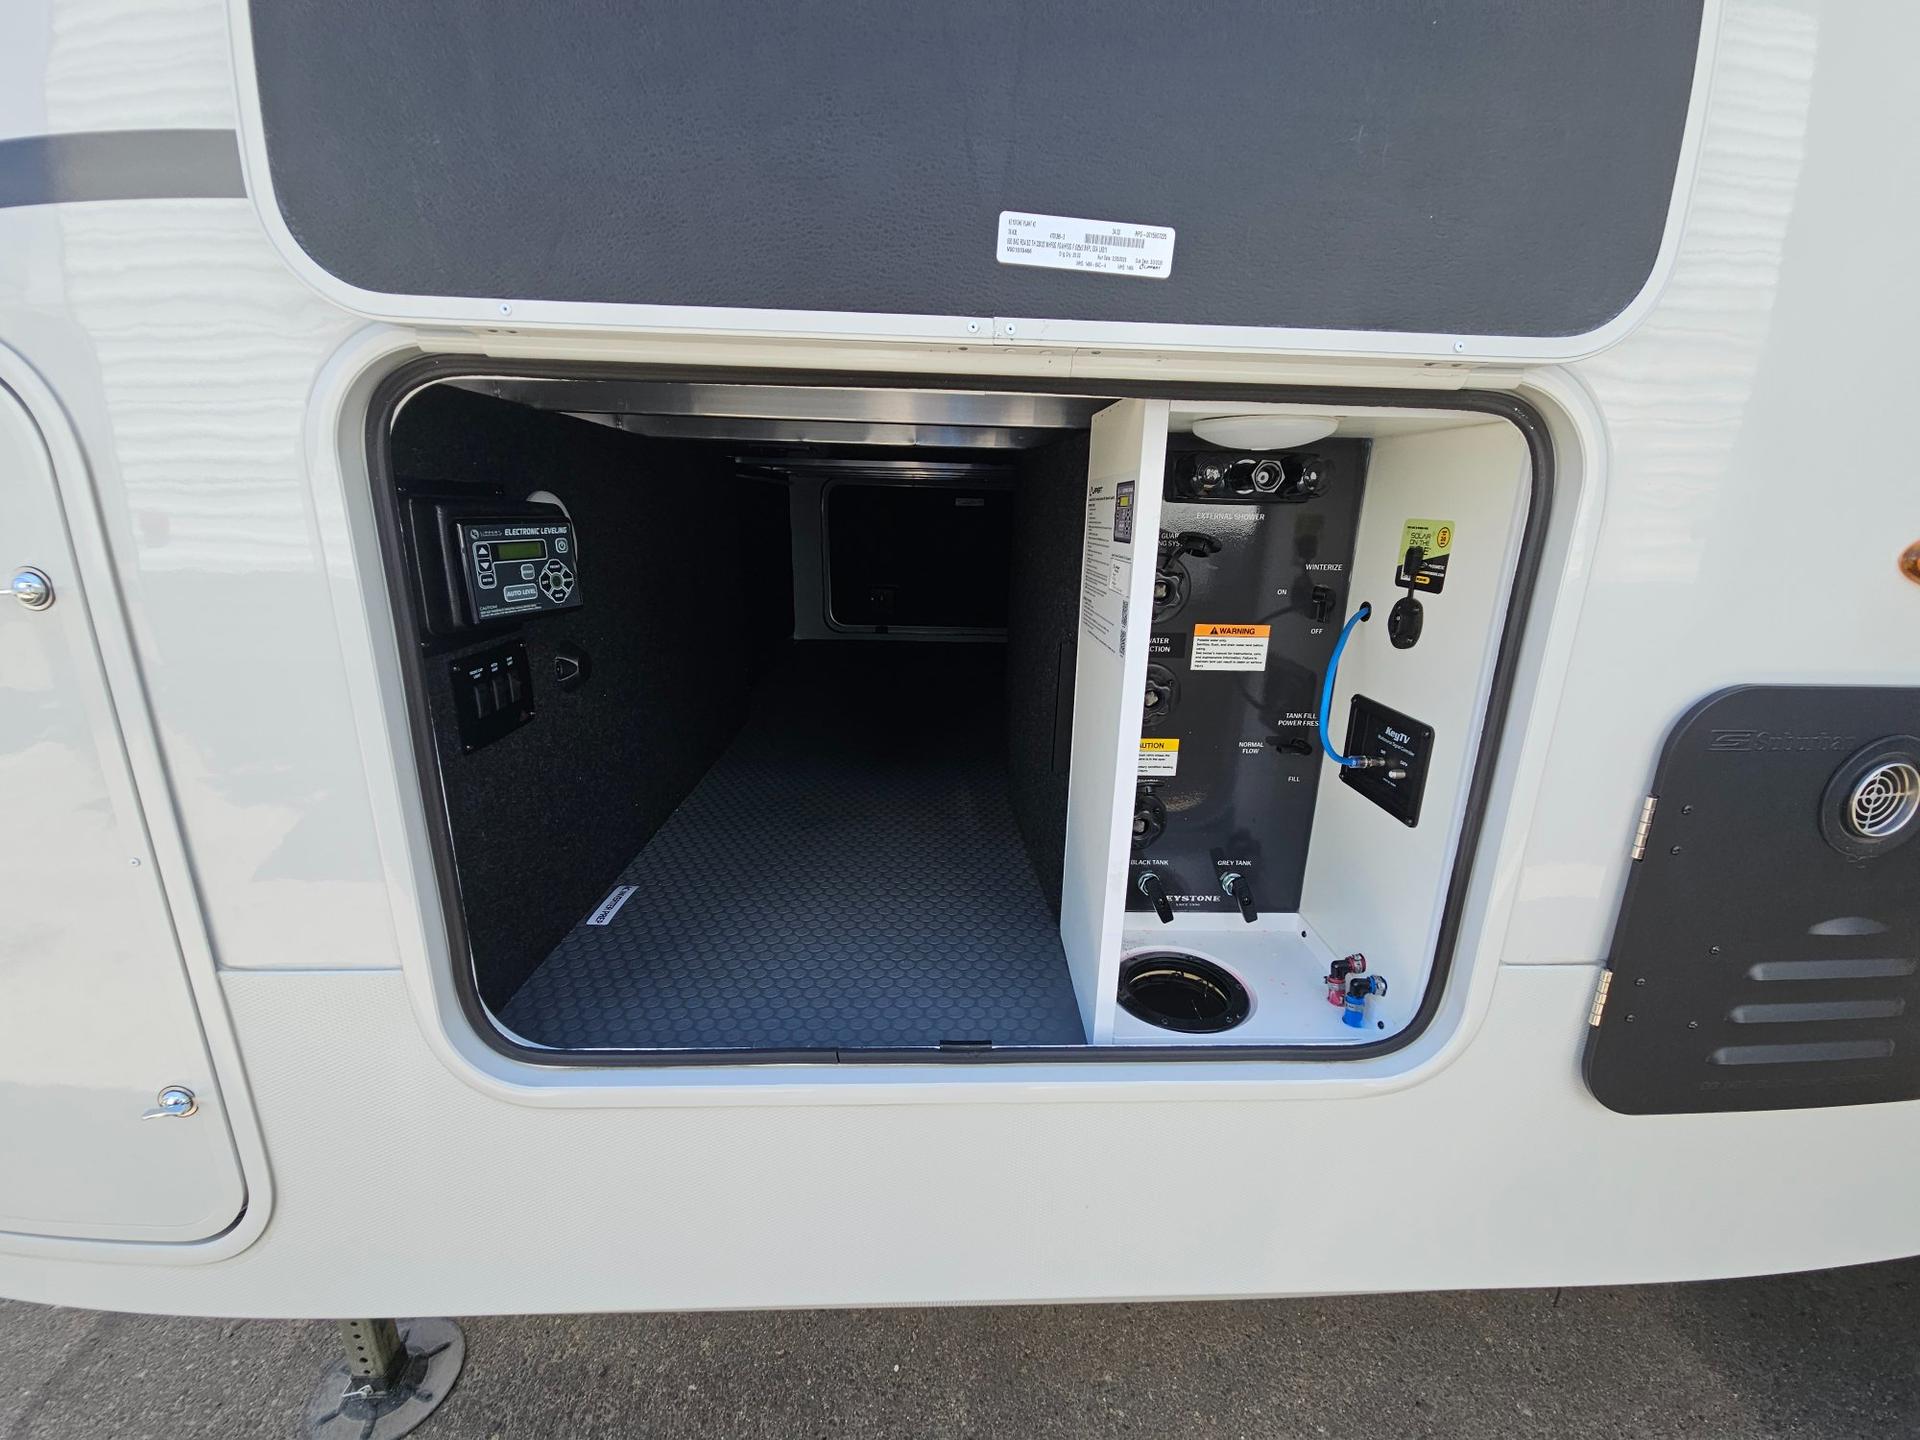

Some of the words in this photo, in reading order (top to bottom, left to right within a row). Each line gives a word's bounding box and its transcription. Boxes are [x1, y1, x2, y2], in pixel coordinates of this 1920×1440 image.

[1195, 512, 1232, 520] EXTERNAL
[1233, 513, 1265, 521] SHOWER
[504, 527, 540, 536] ELECTRONIC
[540, 526, 567, 535] LEVELING
[1161, 532, 1180, 540] GUAR
[1410, 532, 1432, 540] SOLAR
[1305, 563, 1343, 571] WINTERIZE
[522, 588, 536, 596] LEVEL
[1219, 627, 1255, 635] WARNING
[1303, 712, 1317, 720] FILL
[1385, 726, 1411, 744] KeyTV
